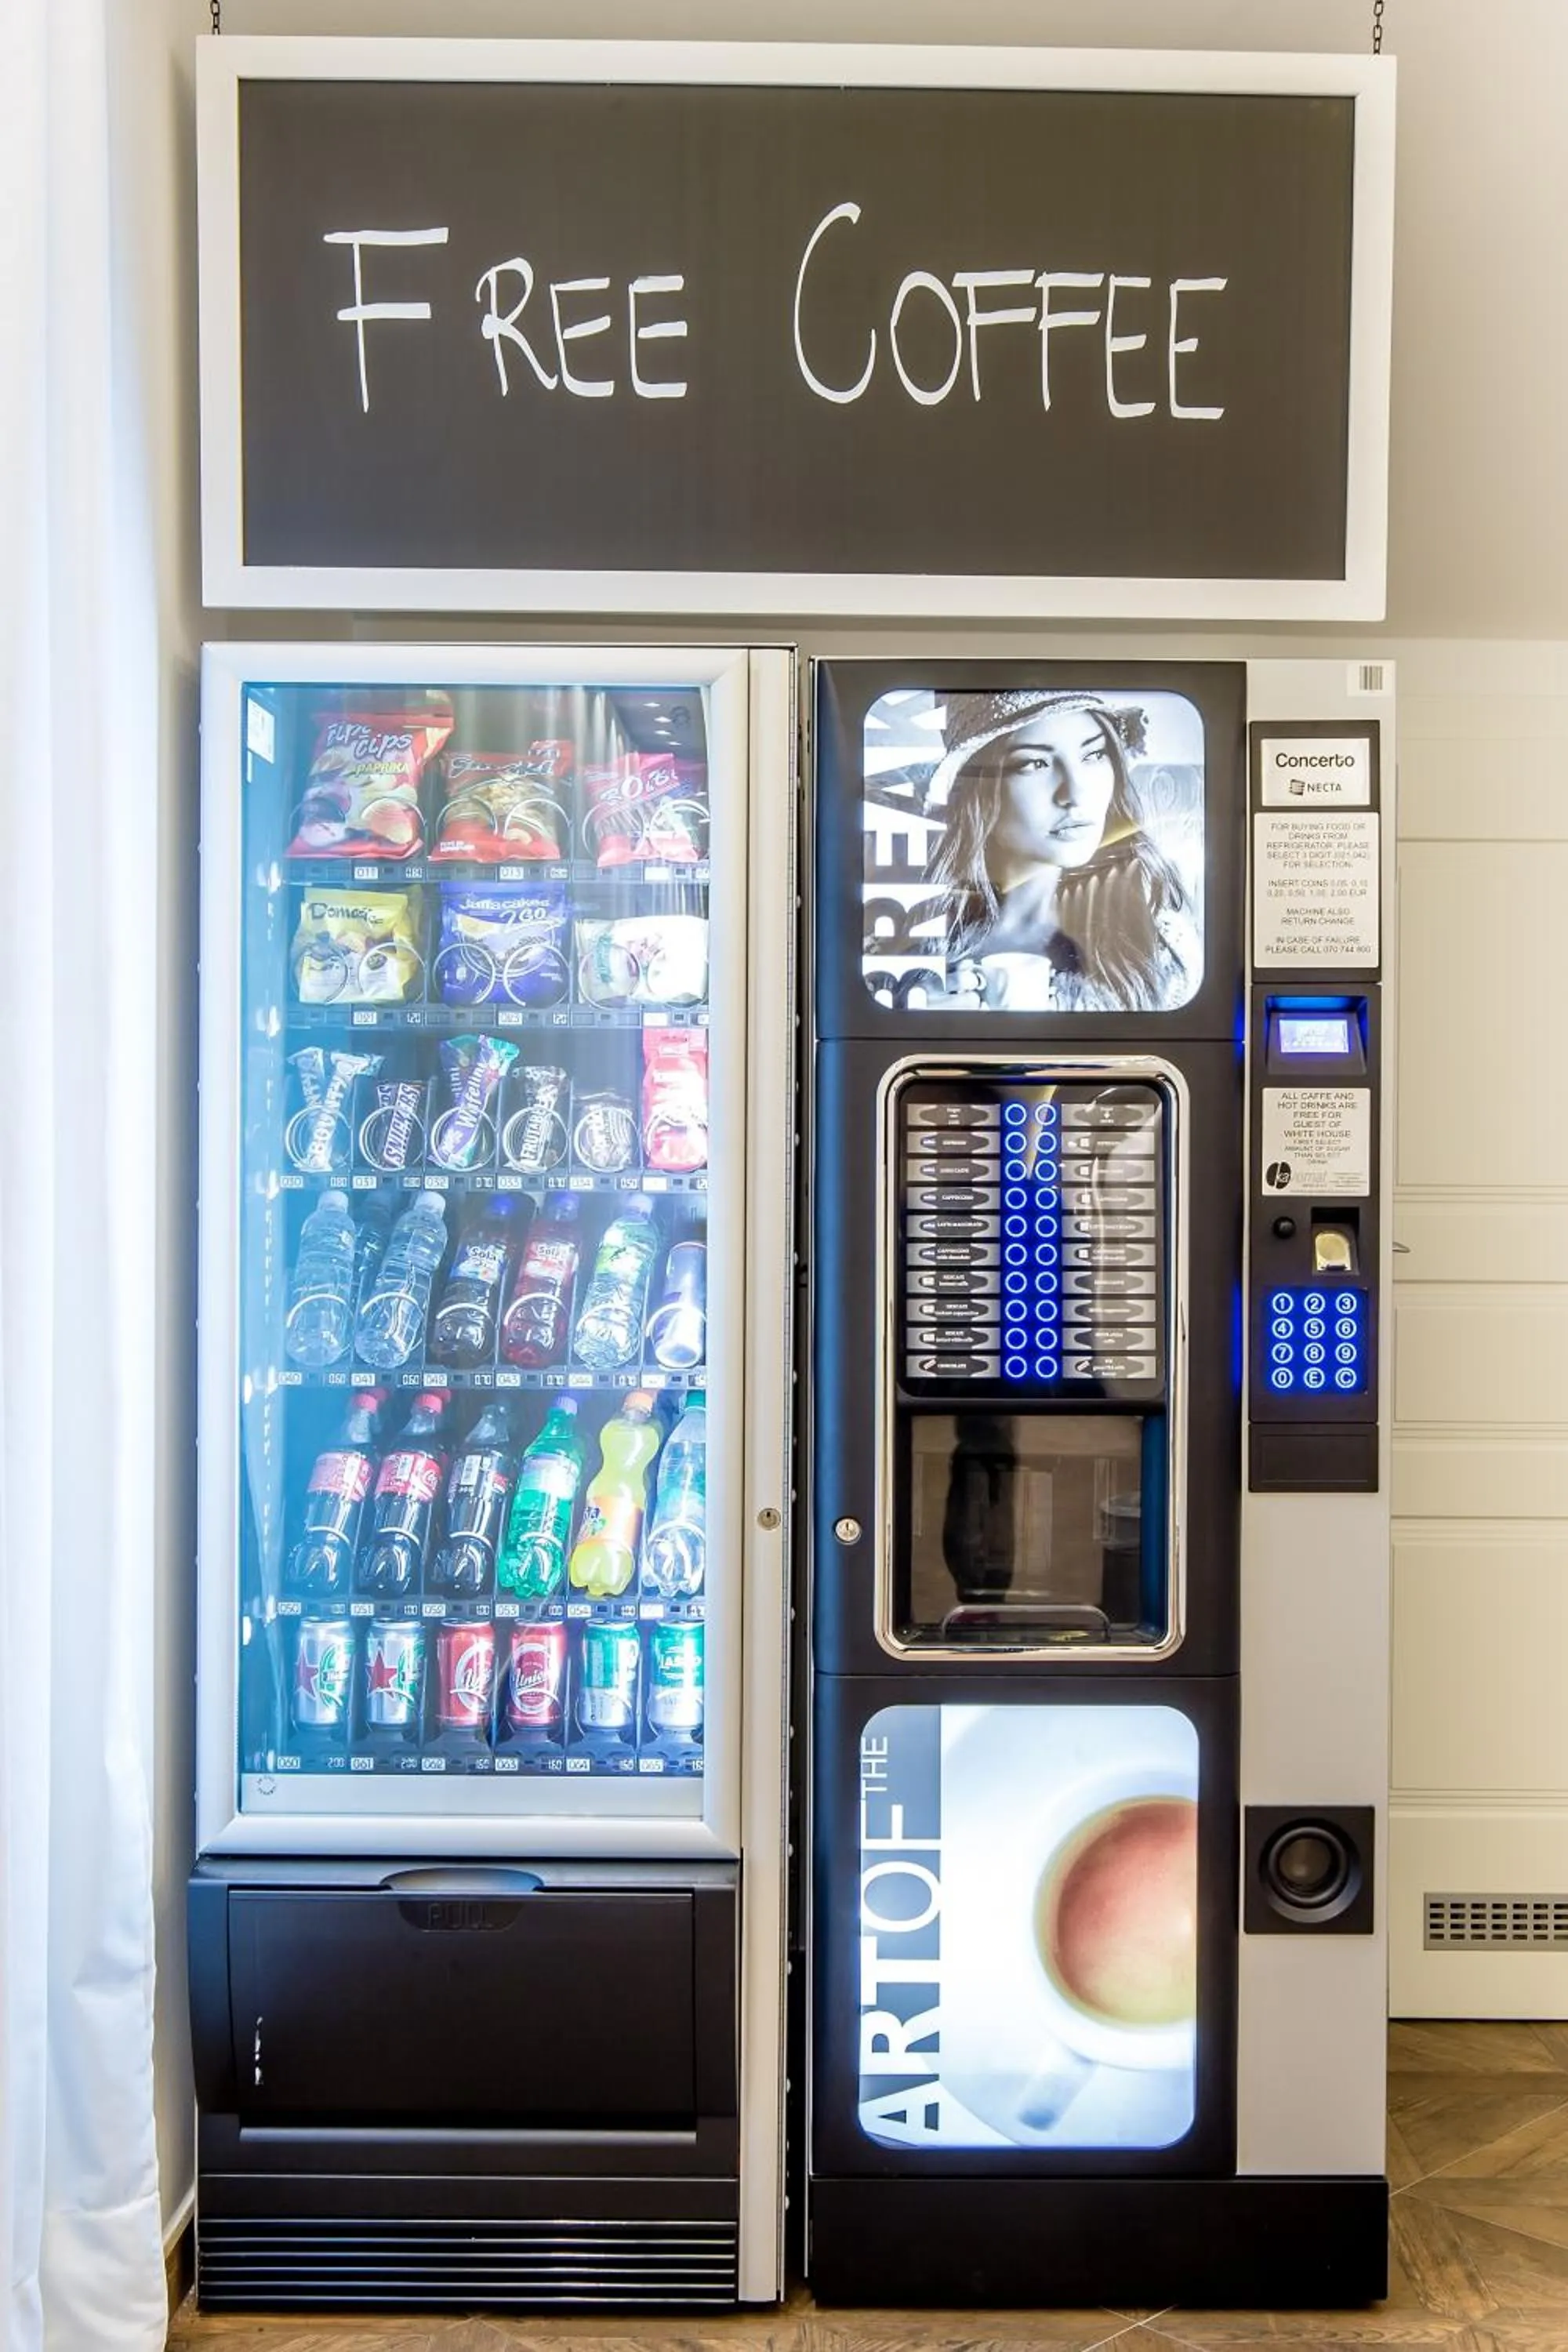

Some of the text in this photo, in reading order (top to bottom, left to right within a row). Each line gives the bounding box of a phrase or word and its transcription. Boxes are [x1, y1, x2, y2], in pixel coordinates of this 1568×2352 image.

[1276, 753, 1355, 768] Concerto
[1307, 783, 1342, 793] NECTA
[862, 689, 947, 1009] BREAK
[860, 1737, 941, 2146] ART OF THE
